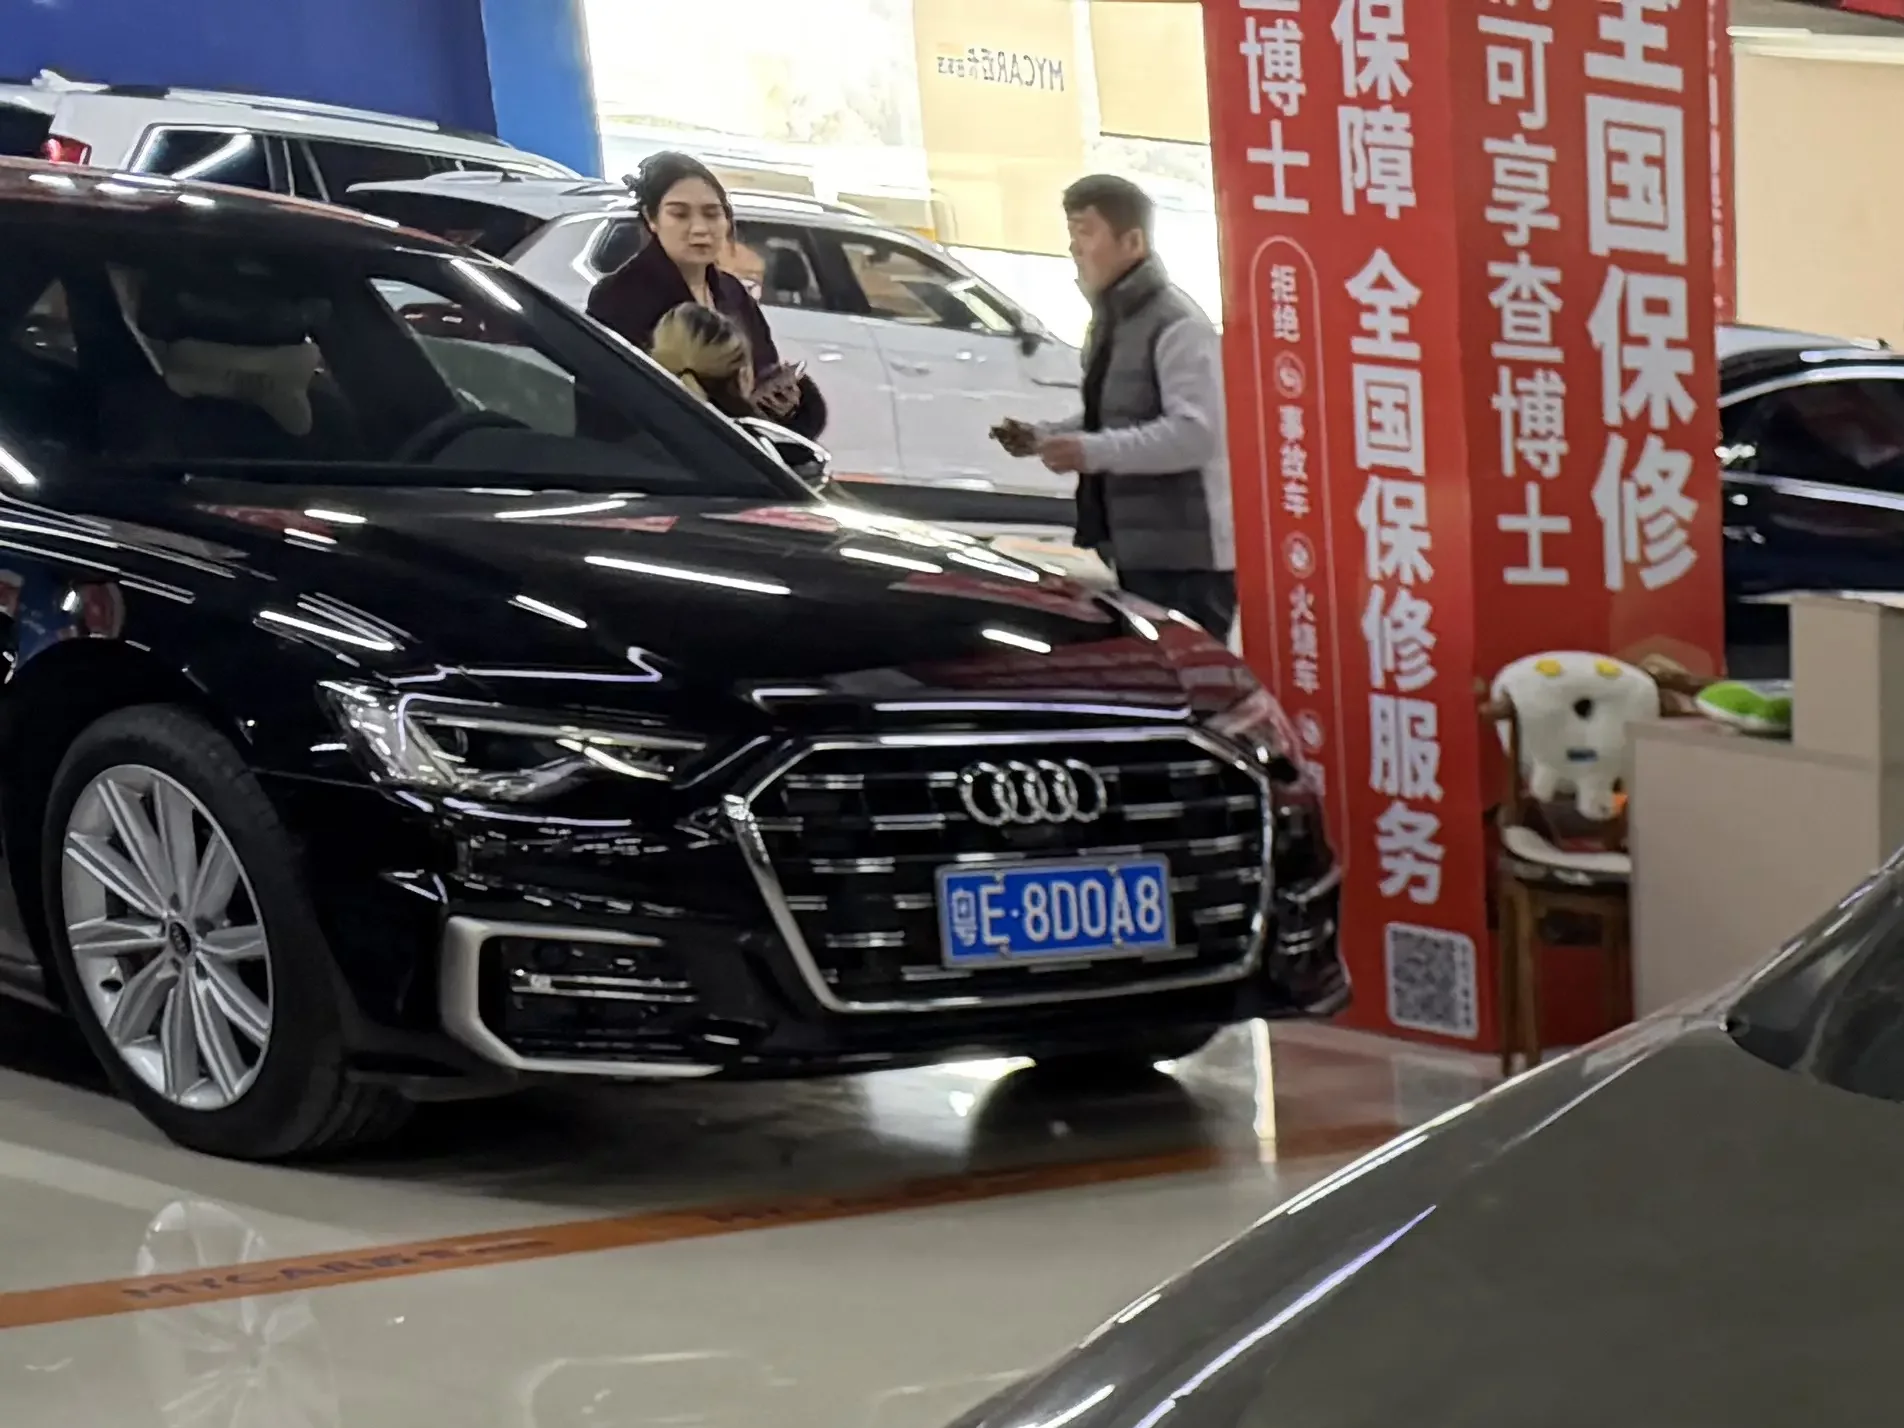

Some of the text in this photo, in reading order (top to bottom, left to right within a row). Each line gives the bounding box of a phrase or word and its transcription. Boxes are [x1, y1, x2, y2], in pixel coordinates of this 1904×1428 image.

[1239, 0, 1311, 215] 博士
[1477, 0, 1571, 586] 可享查博士
[1331, 0, 1446, 904] 保障 全国保修服务
